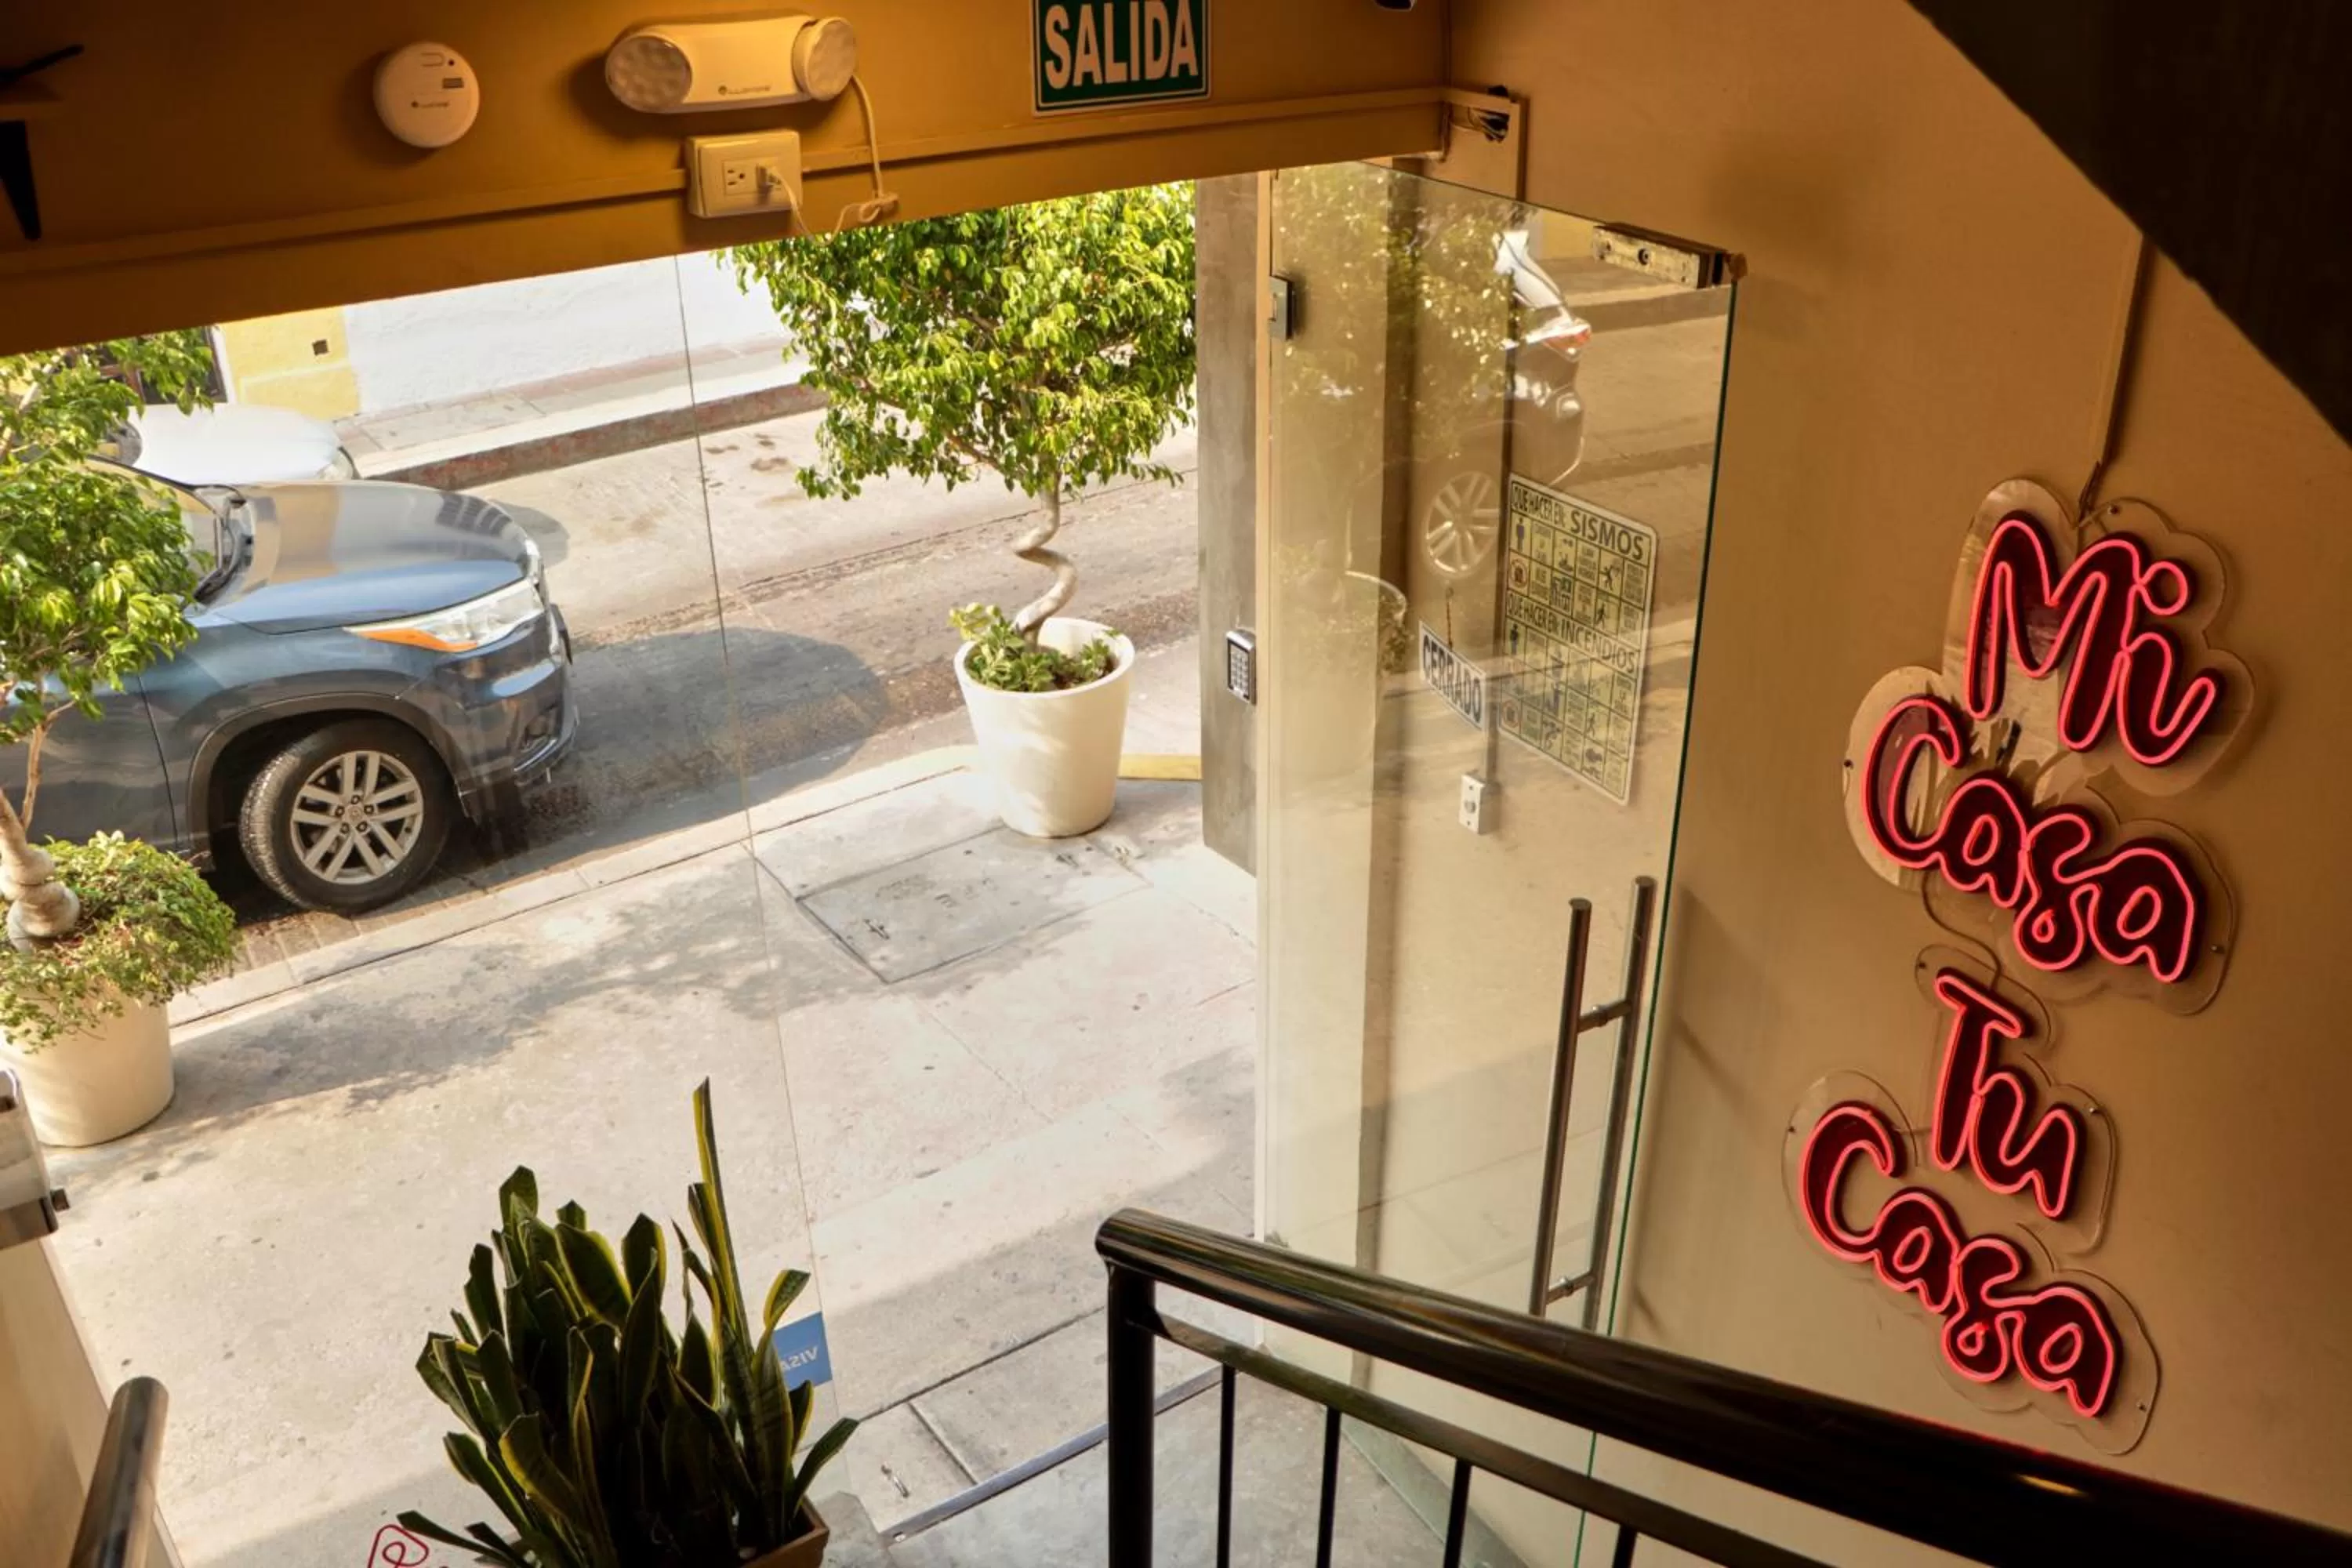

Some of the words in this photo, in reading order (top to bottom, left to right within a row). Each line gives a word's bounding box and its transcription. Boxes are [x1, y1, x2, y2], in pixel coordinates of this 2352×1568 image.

[1045, 0, 1199, 90] SALIDA
[1570, 509, 1644, 560] SISMOS
[1423, 634, 1482, 724] CERRADO
[1561, 619, 1635, 674] INCENDIOS
[1965, 514, 2219, 765] Mi
[1861, 695, 2199, 983] Casa
[1932, 972, 2082, 1218] Tu
[1801, 1102, 2118, 1417] Casa
